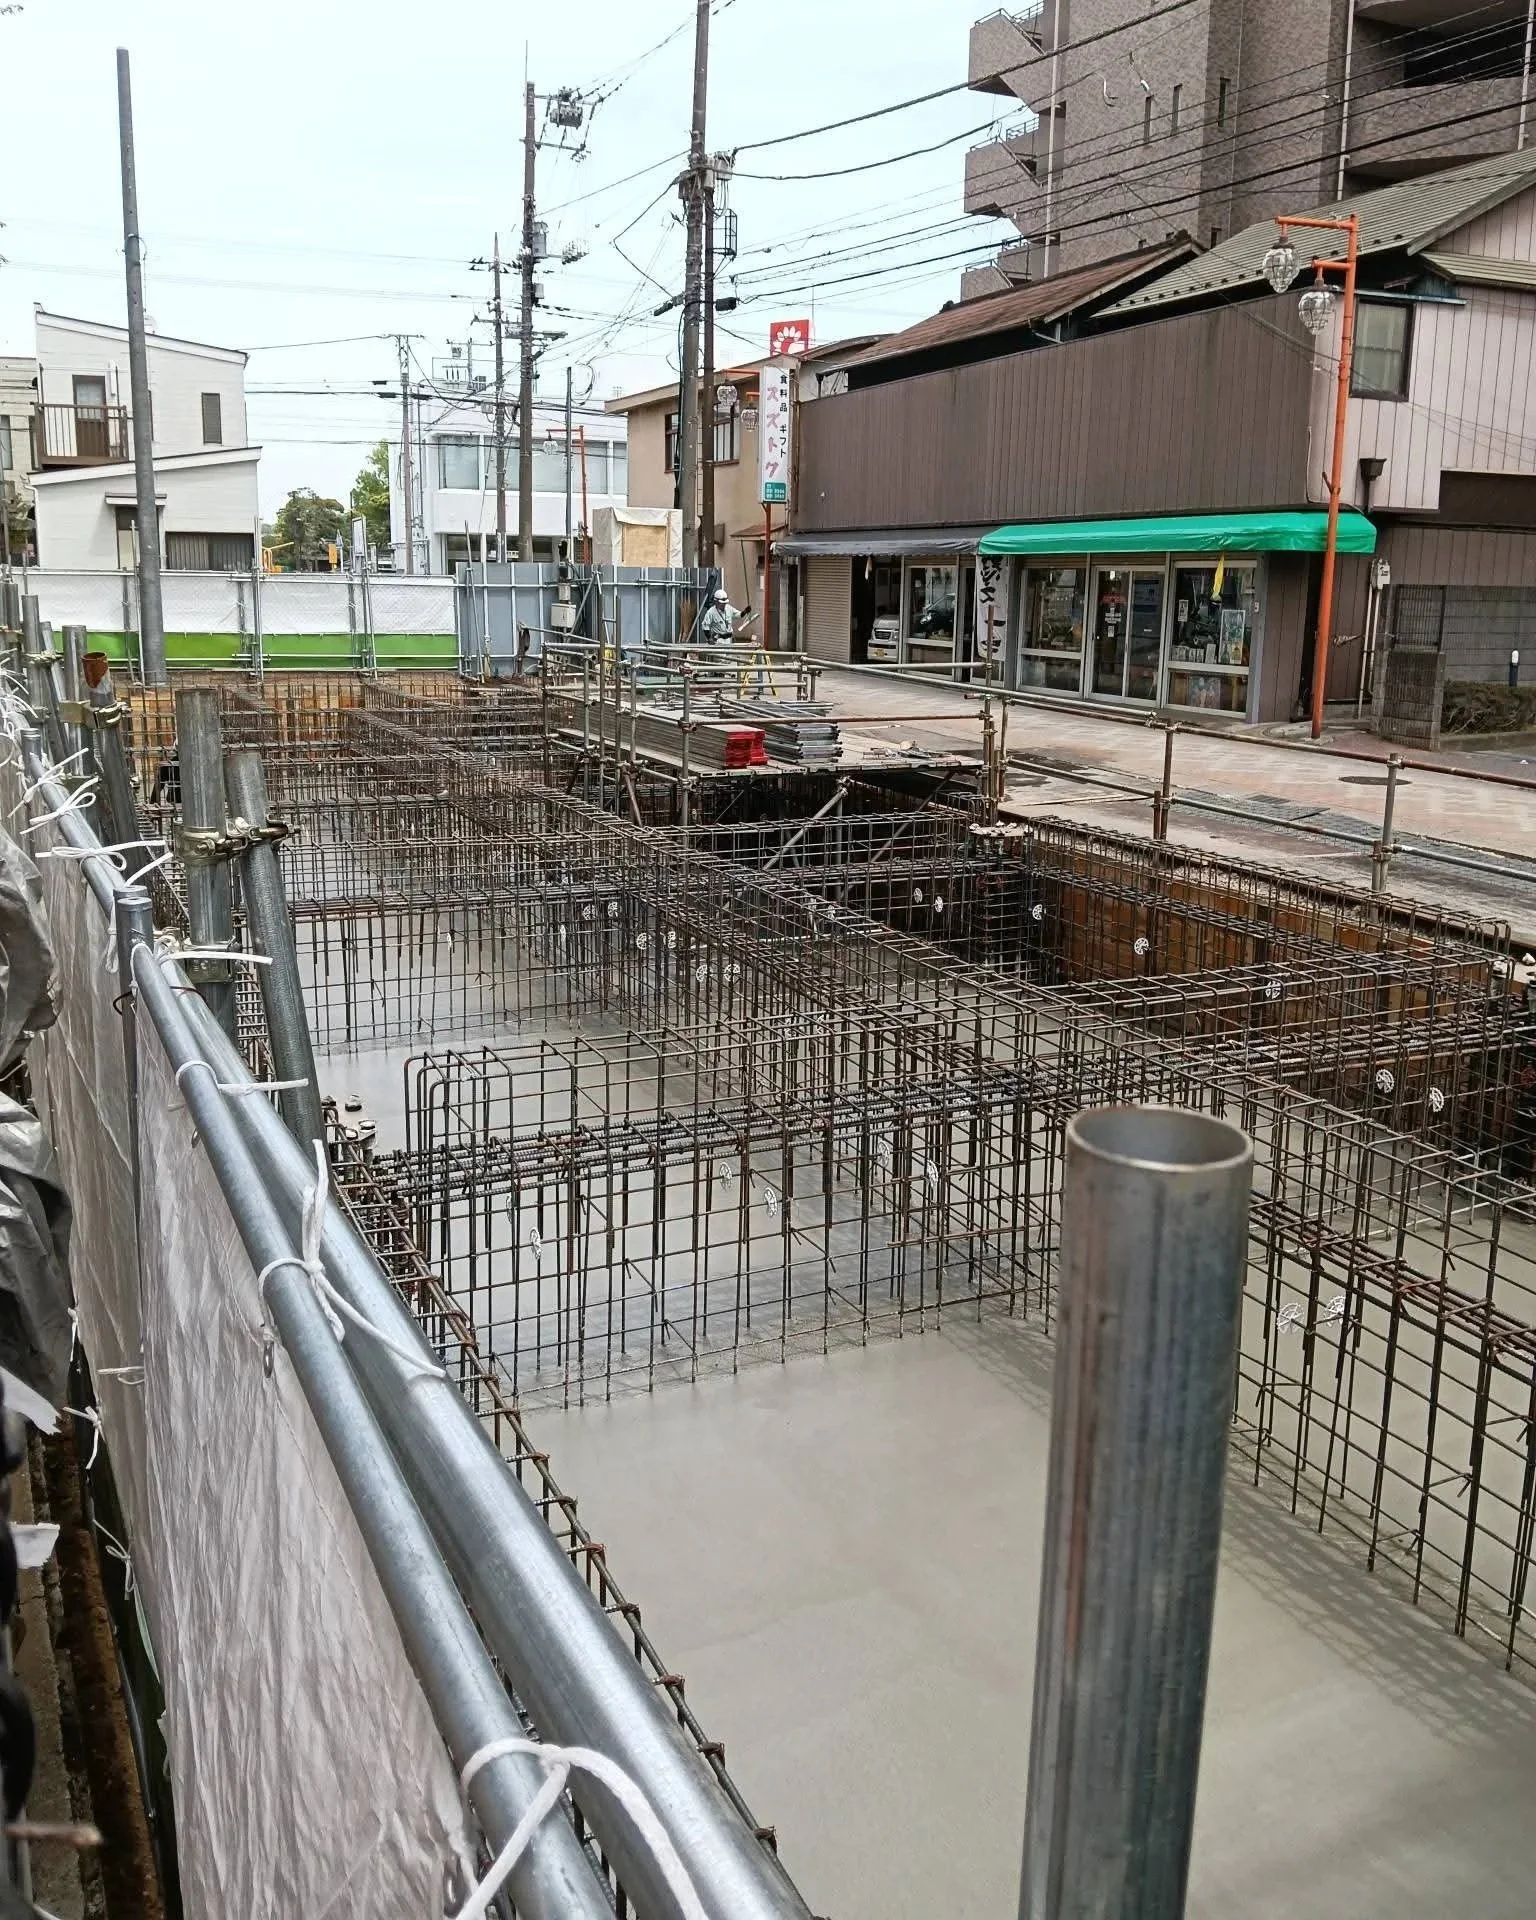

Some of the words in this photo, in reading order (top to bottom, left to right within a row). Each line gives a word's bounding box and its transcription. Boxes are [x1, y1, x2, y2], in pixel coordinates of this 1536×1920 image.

[779, 374, 788, 412] 食料品
[779, 423, 787, 458] ギフト
